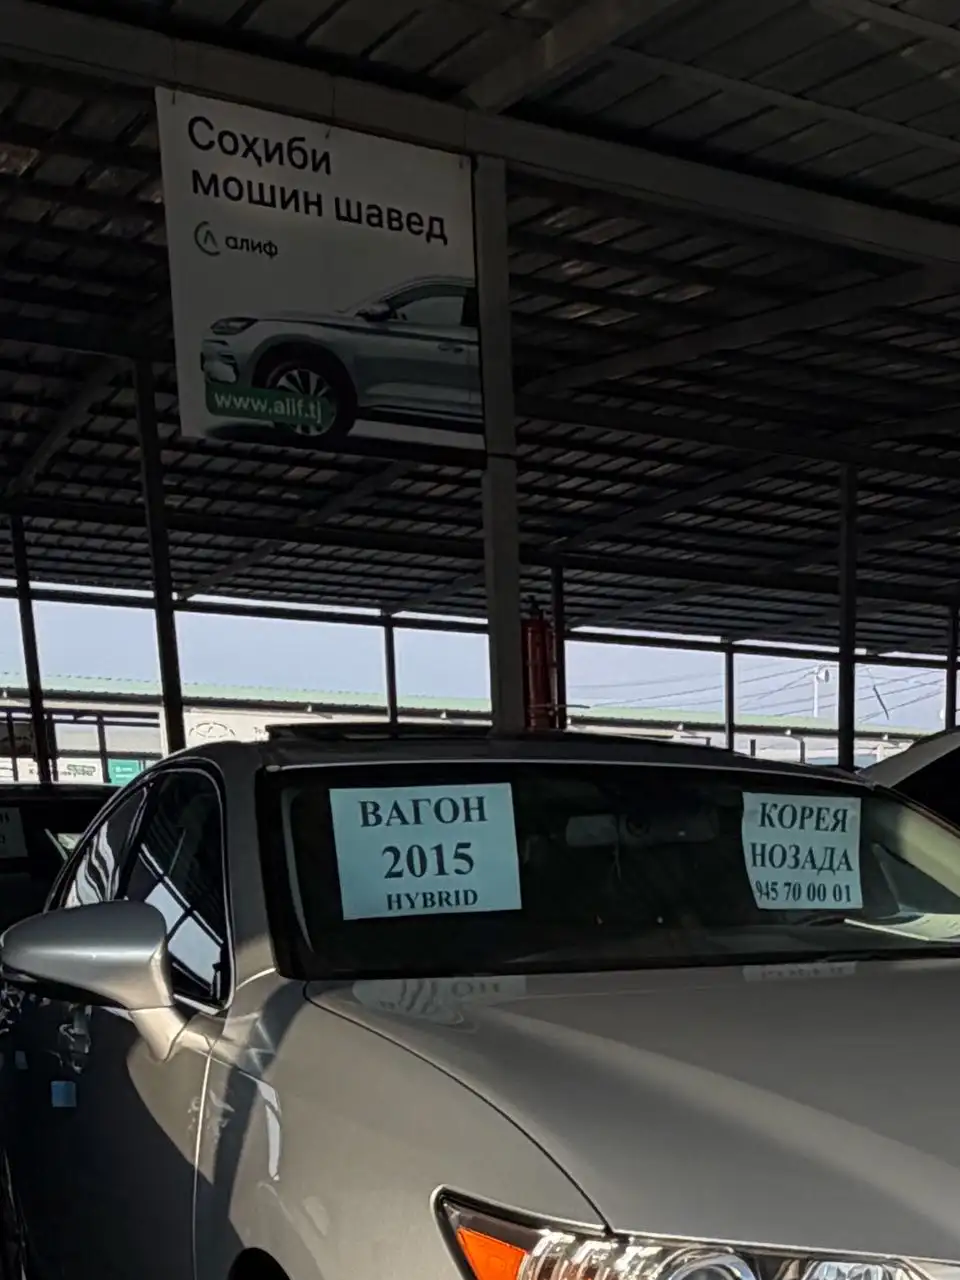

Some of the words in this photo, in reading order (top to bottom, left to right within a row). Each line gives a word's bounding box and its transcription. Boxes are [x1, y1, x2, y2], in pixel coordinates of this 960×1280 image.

[187, 115, 332, 176] Соҳиби
[191, 168, 323, 218] мошин
[334, 195, 448, 246] шавед
[225, 234, 278, 258] алиф
[213, 391, 322, 424] www.alif.tj
[358, 796, 487, 828] ВАГОН
[758, 802, 848, 833] КОРЕЯ
[382, 842, 474, 879] 2015
[749, 842, 853, 876] НОЗАДА
[386, 888, 478, 911] HYBRID
[784, 882, 802, 902] 70
[807, 883, 827, 903] 00
[832, 884, 852, 903] 01
